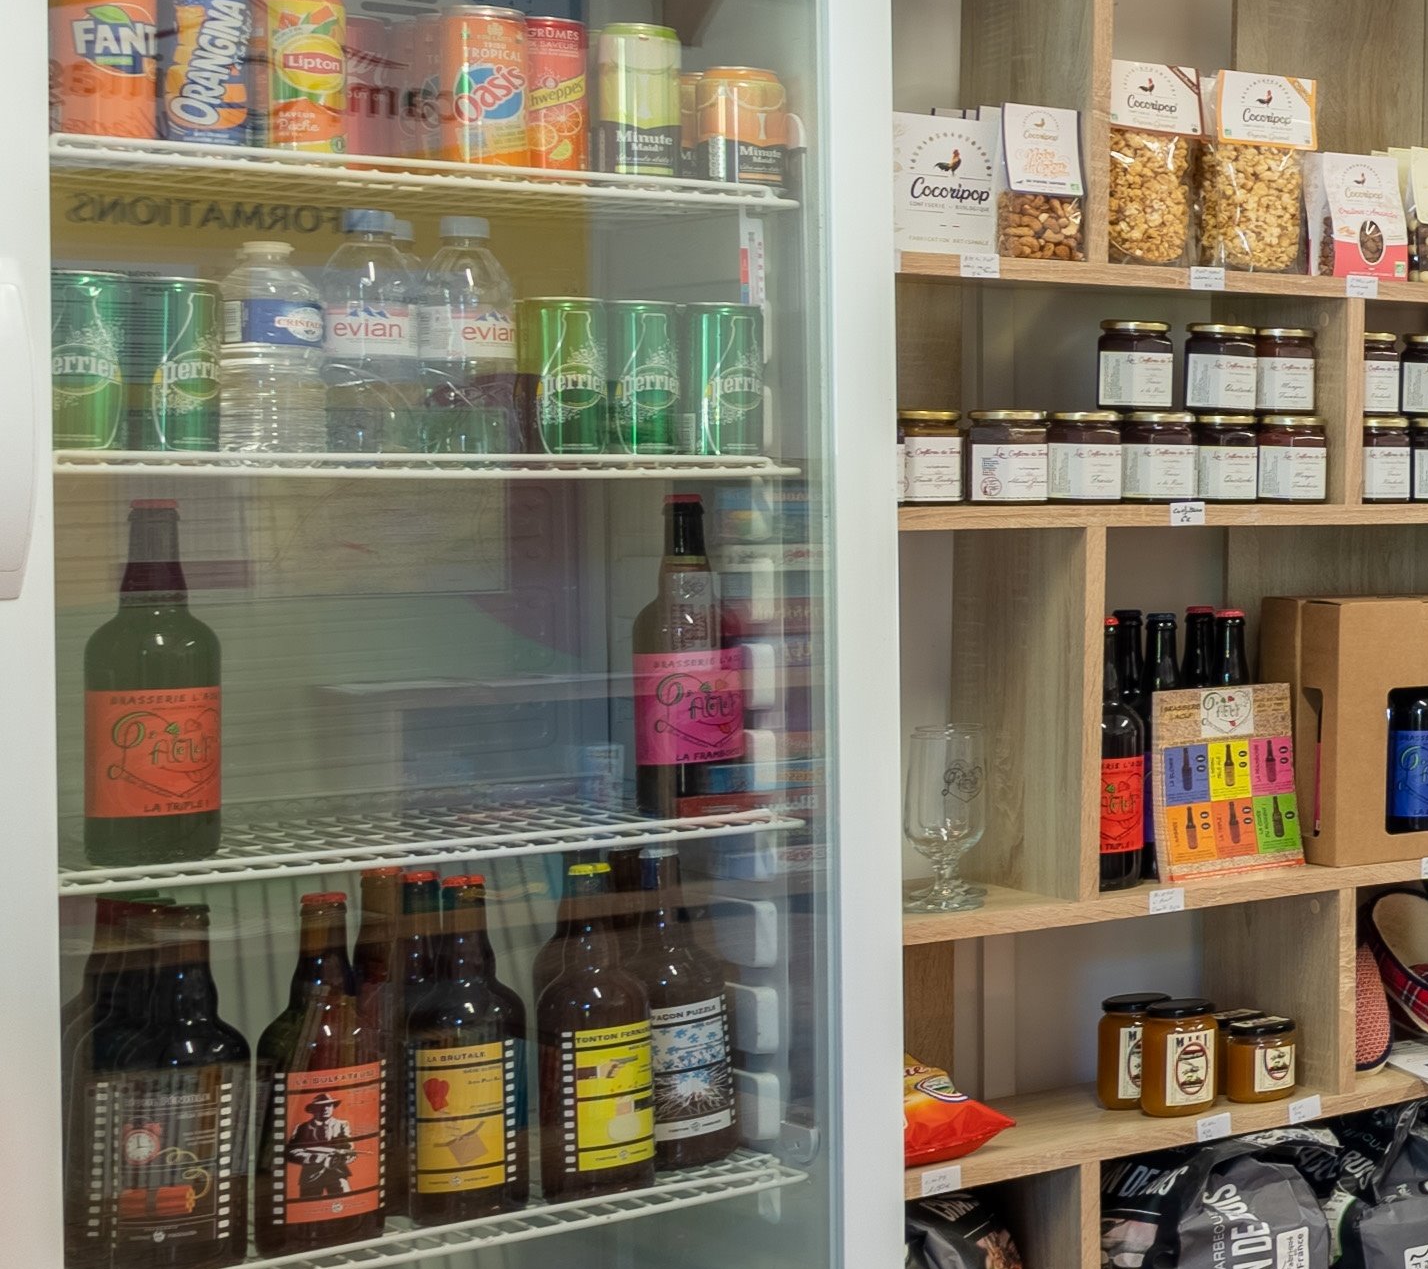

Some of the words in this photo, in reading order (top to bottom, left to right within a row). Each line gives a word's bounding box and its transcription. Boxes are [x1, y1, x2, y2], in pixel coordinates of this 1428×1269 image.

[72, 20, 157, 55] FANT
[170, 0, 246, 125] ORANGINA
[288, 54, 340, 71] Lipton
[454, 65, 525, 124] Oasis
[1127, 94, 1177, 117] Cocoripop
[1242, 108, 1292, 130] Cocoripop
[615, 128, 673, 145] Minute
[911, 176, 990, 205] Cocoripop
[333, 321, 402, 345] evian
[1231, 1221, 1272, 1257] DE
[1296, 1233, 1304, 1269] France
